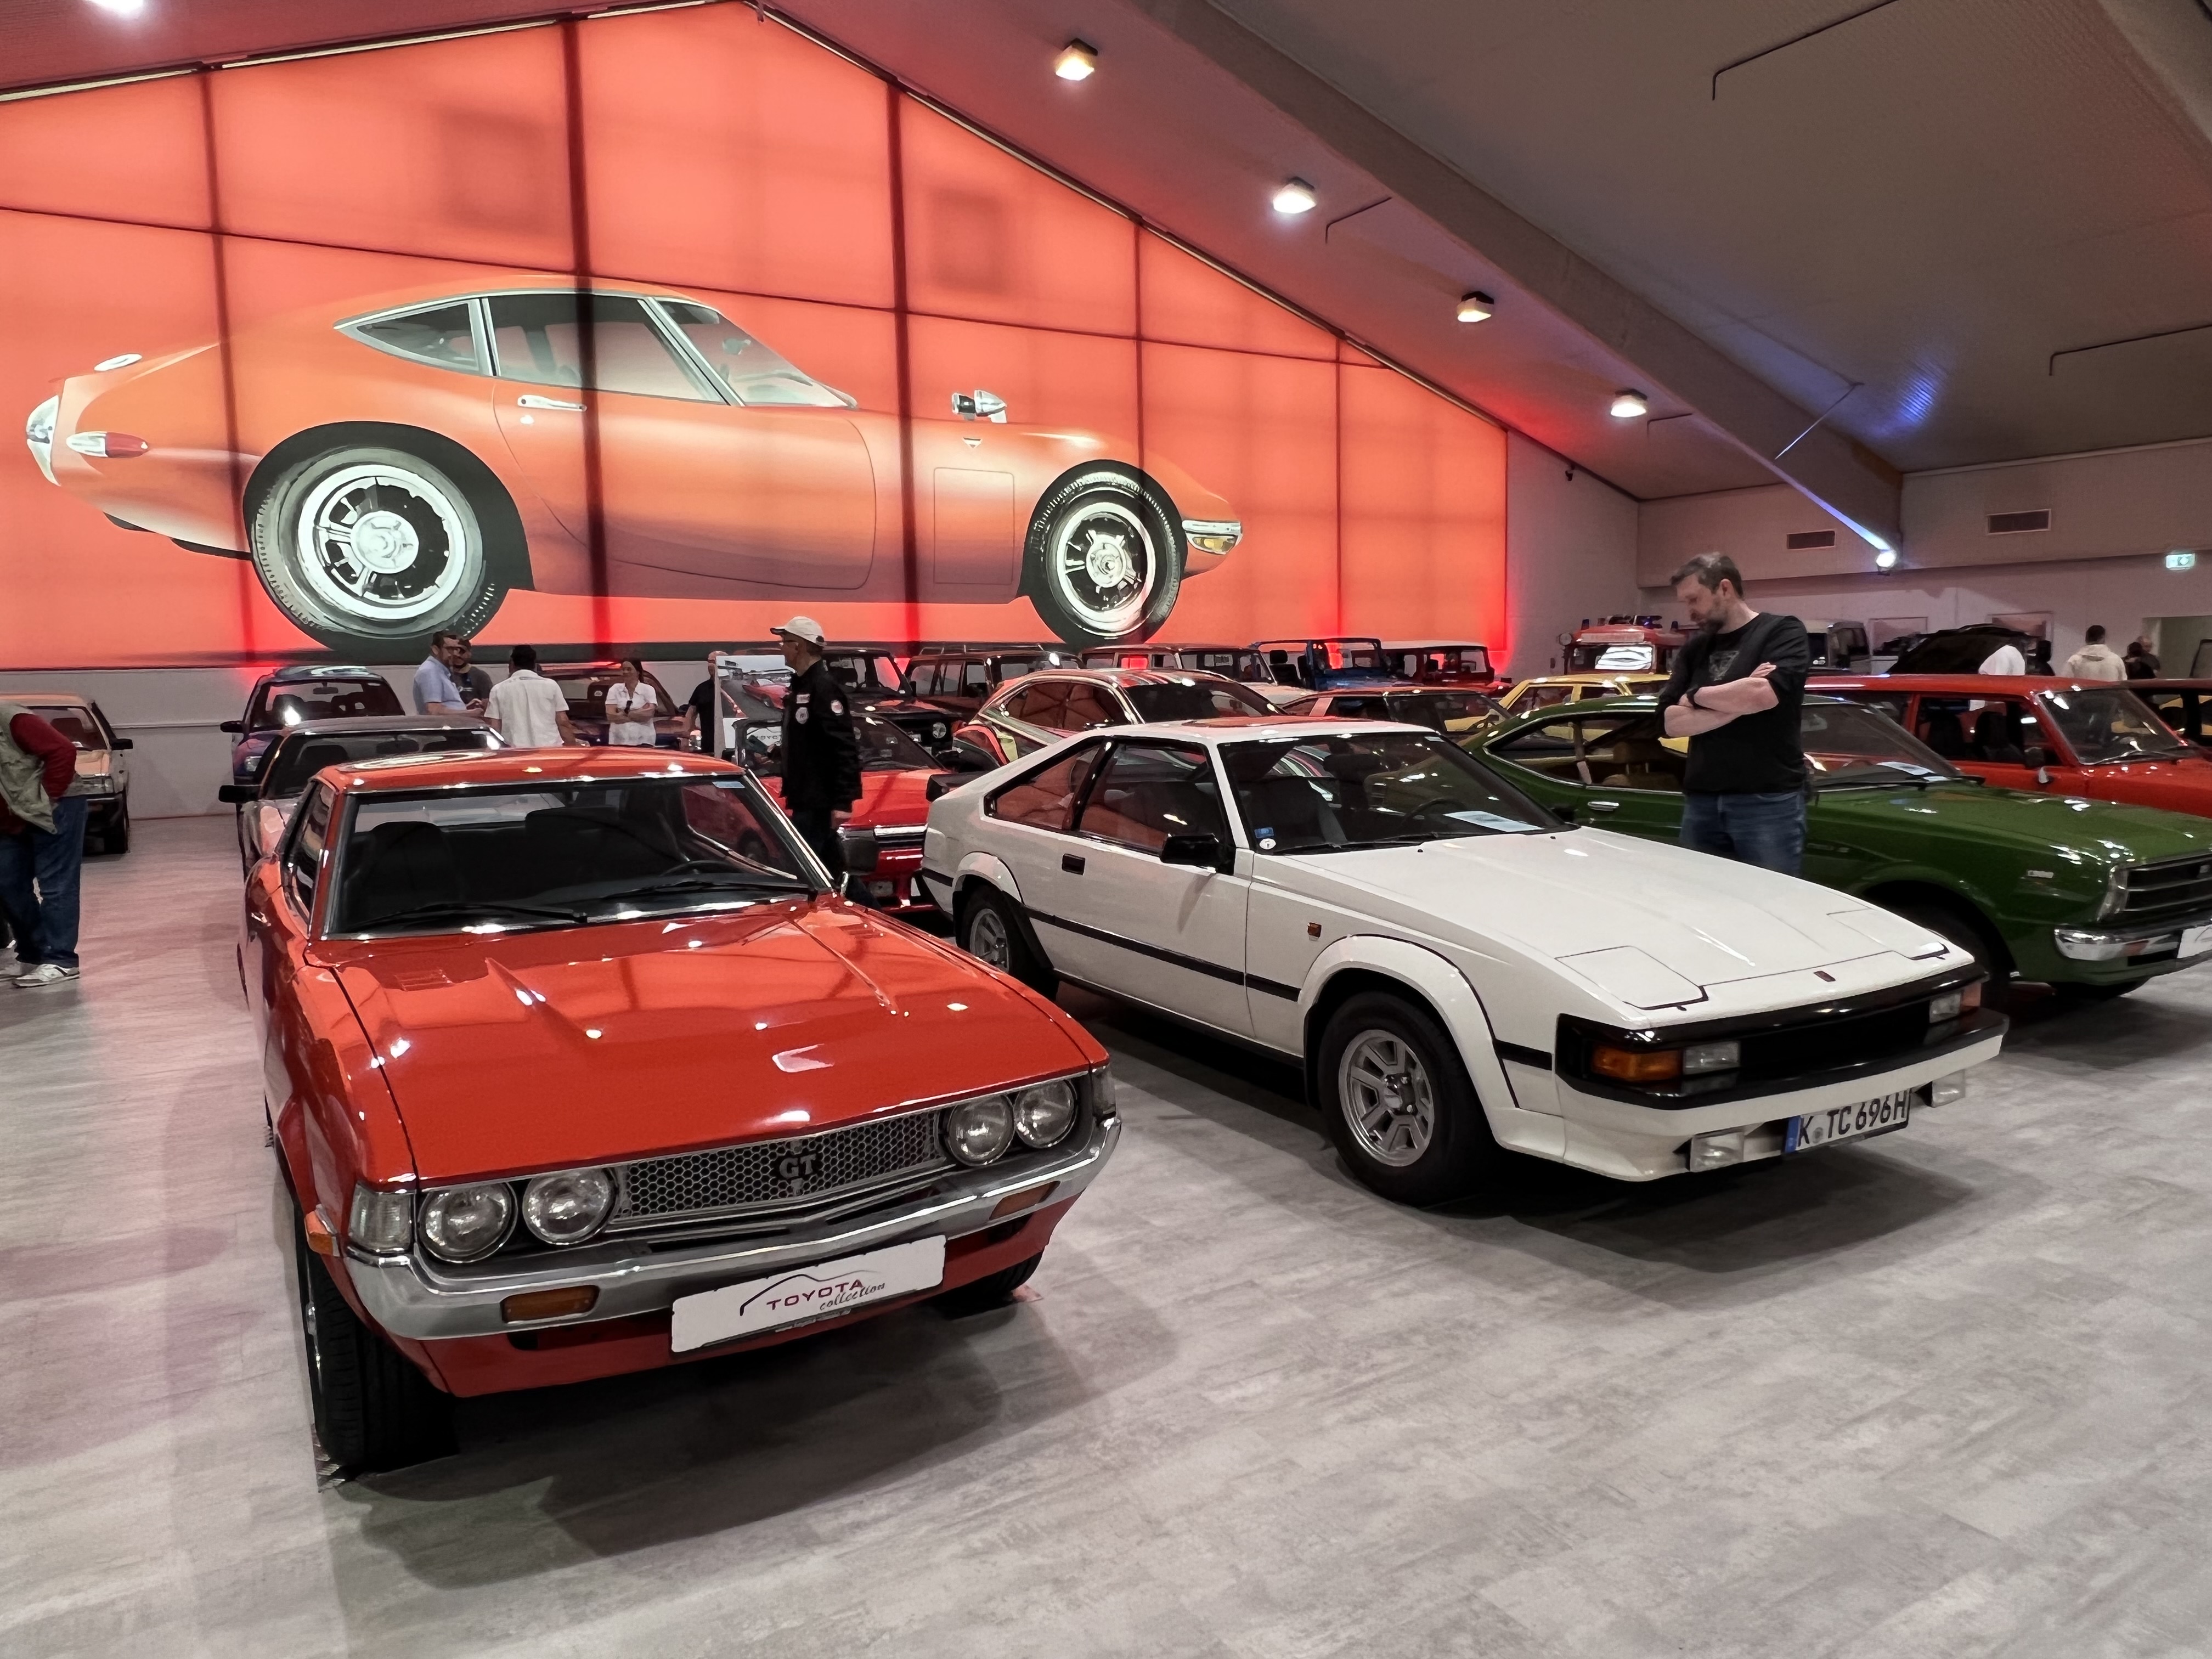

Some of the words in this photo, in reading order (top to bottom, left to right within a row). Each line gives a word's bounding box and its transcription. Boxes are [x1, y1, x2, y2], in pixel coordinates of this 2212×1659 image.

[1798, 1115, 1814, 1147] K
[1826, 1105, 1852, 1139] TC
[779, 1154, 816, 1178] GT
[766, 1279, 864, 1310] TOYOTA
[820, 1283, 885, 1311] collection
